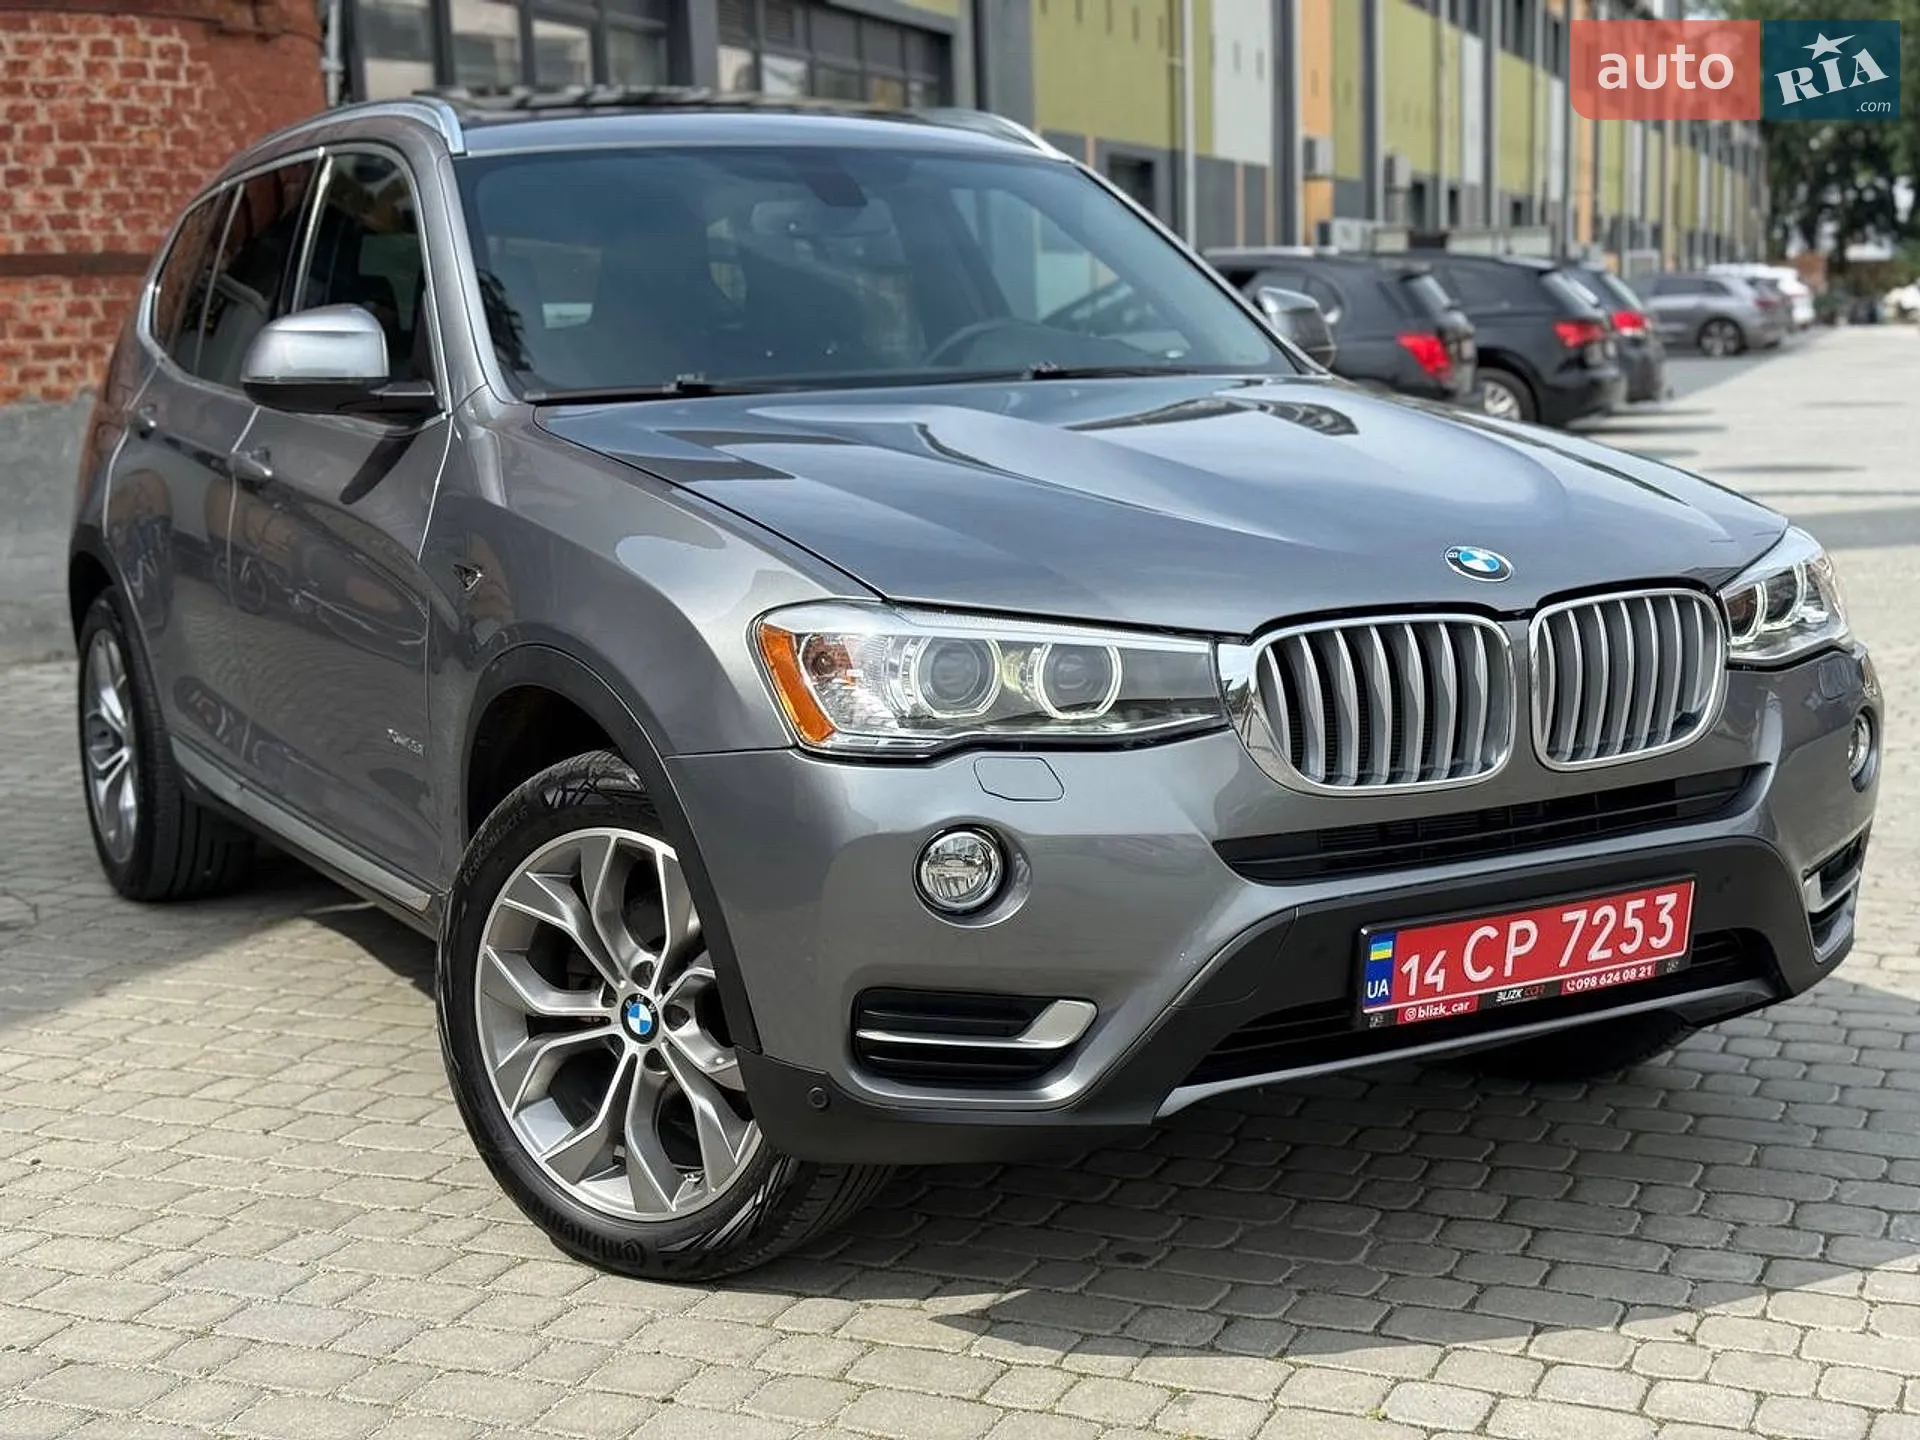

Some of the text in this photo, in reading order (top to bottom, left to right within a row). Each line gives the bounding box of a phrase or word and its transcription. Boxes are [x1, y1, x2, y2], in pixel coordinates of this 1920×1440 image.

[1400, 892, 1678, 996] 14 CP 7253
[1367, 978, 1389, 999] UA
[1576, 964, 1653, 991] 098 624 08 21
[1404, 1001, 1471, 1022] @blizk_car
